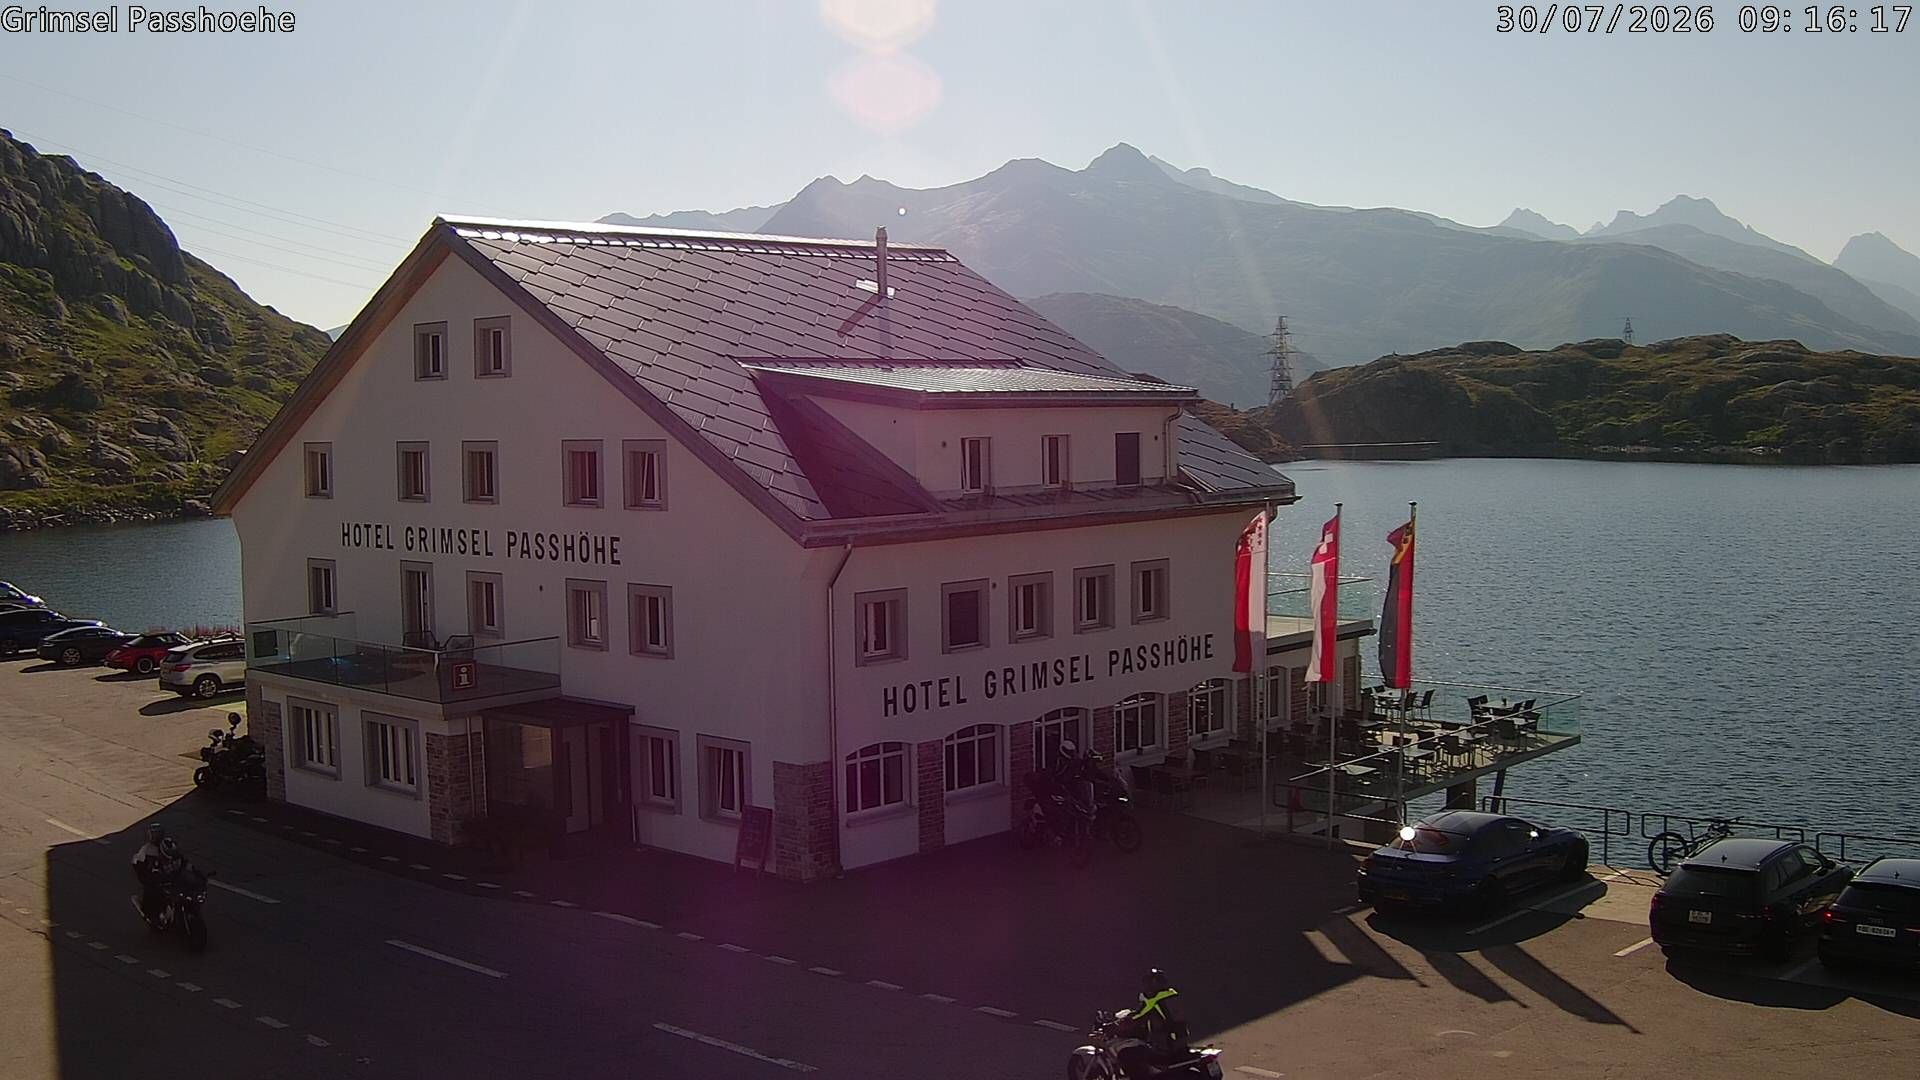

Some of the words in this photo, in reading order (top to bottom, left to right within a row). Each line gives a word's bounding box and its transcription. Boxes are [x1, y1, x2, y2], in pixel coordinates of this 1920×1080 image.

[341, 522, 394, 550] HOTEL
[405, 526, 494, 556] GRIMSEL
[507, 530, 621, 565] PASSHÖHE
[883, 676, 967, 718] HOTEL
[984, 654, 1095, 700] GRIMSEL
[1108, 633, 1214, 677] PASSHÖHE
